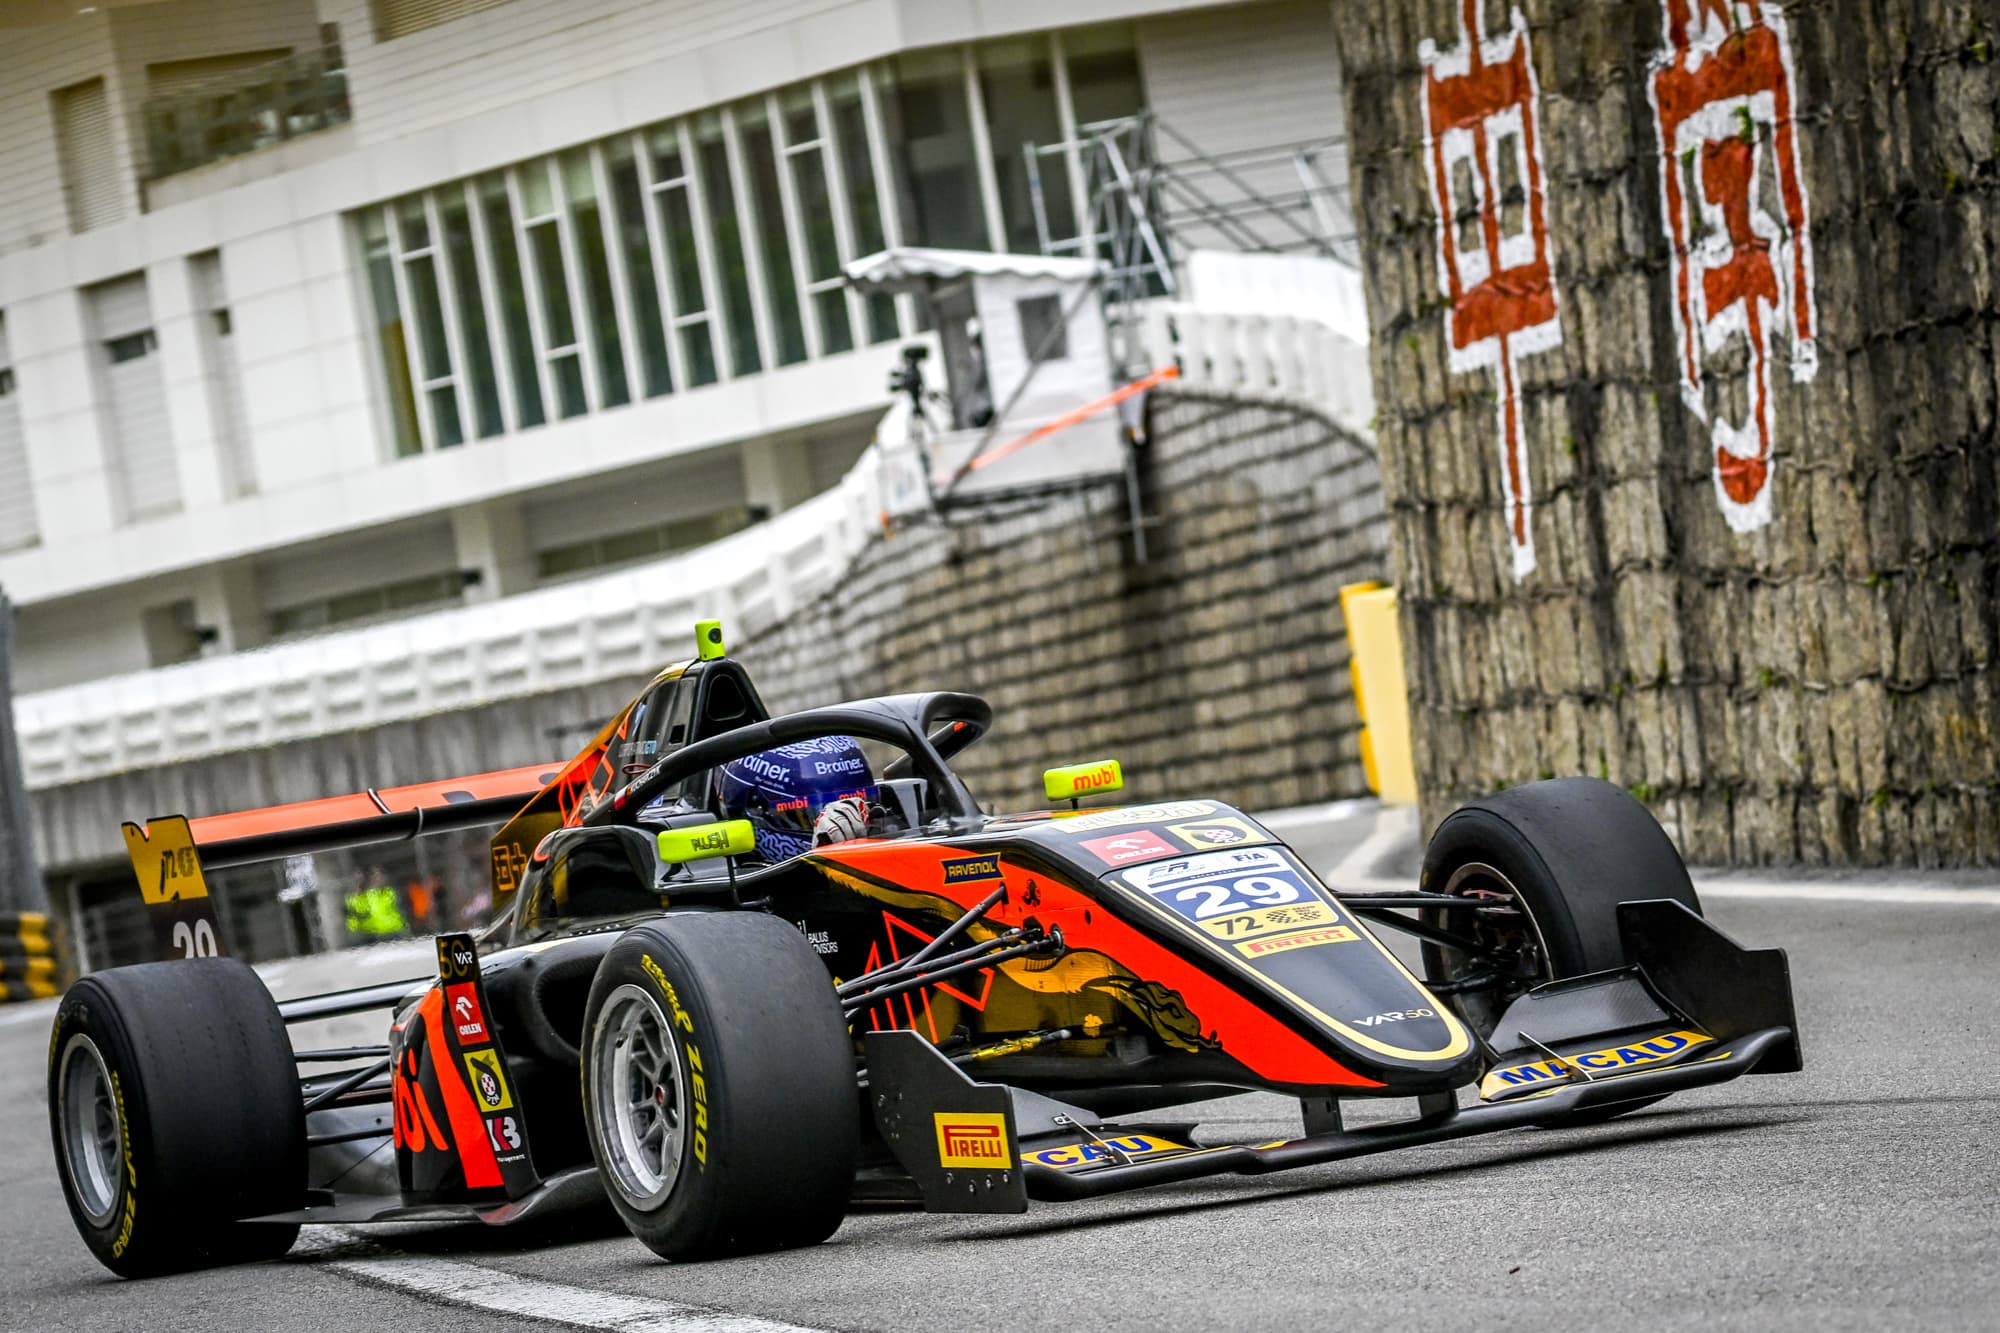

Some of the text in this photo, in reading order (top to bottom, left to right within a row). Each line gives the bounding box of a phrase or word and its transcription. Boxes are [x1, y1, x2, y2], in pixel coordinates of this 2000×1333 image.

[733, 752, 791, 783] rainer.
[815, 757, 864, 776] Brainer.
[1073, 765, 1116, 790] mubi
[775, 796, 809, 812] mubi
[1232, 852, 1267, 863] FIA
[947, 861, 996, 877] RAVENOL
[1149, 861, 1190, 877] FR
[1175, 877, 1299, 918] 29
[1213, 917, 1264, 935] 72
[1247, 929, 1346, 952] PIRELLI
[454, 951, 473, 964] VAR
[459, 1023, 482, 1036] ORLEN
[1499, 1034, 1688, 1086] MACAU
[686, 1042, 709, 1167] ZERO
[942, 1125, 1002, 1158] PIRELLI
[1034, 1136, 1153, 1166] CAU
